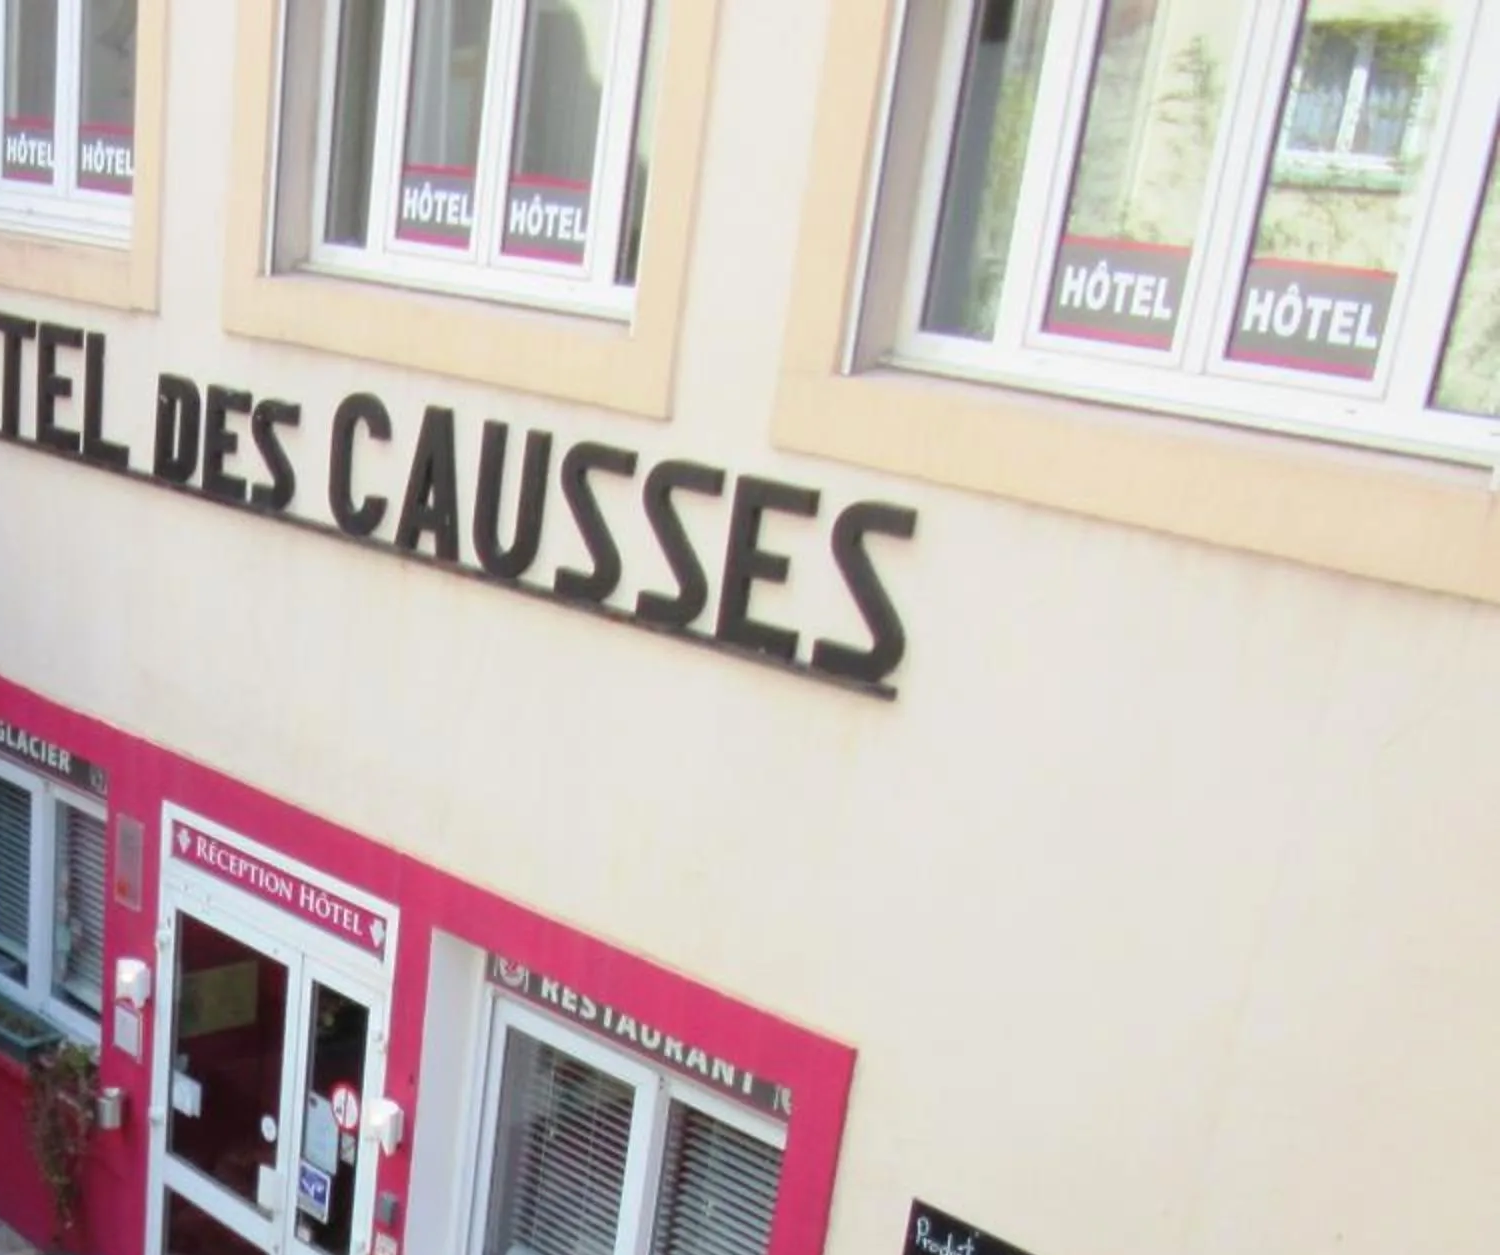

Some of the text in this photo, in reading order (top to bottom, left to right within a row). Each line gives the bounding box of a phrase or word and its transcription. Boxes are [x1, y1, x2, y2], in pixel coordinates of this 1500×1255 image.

[6, 132, 54, 168] HÔTEL
[82, 139, 135, 176] HÔTEL
[402, 182, 474, 226] HÔTEL
[509, 194, 587, 242] HÔTEL
[1059, 261, 1173, 320] HÔTEL
[1242, 282, 1378, 349] HÔTEL
[153, 373, 300, 512] DES
[328, 392, 918, 684] CAUSSES
[195, 835, 363, 937] RÉCEPTION HÔTEL
